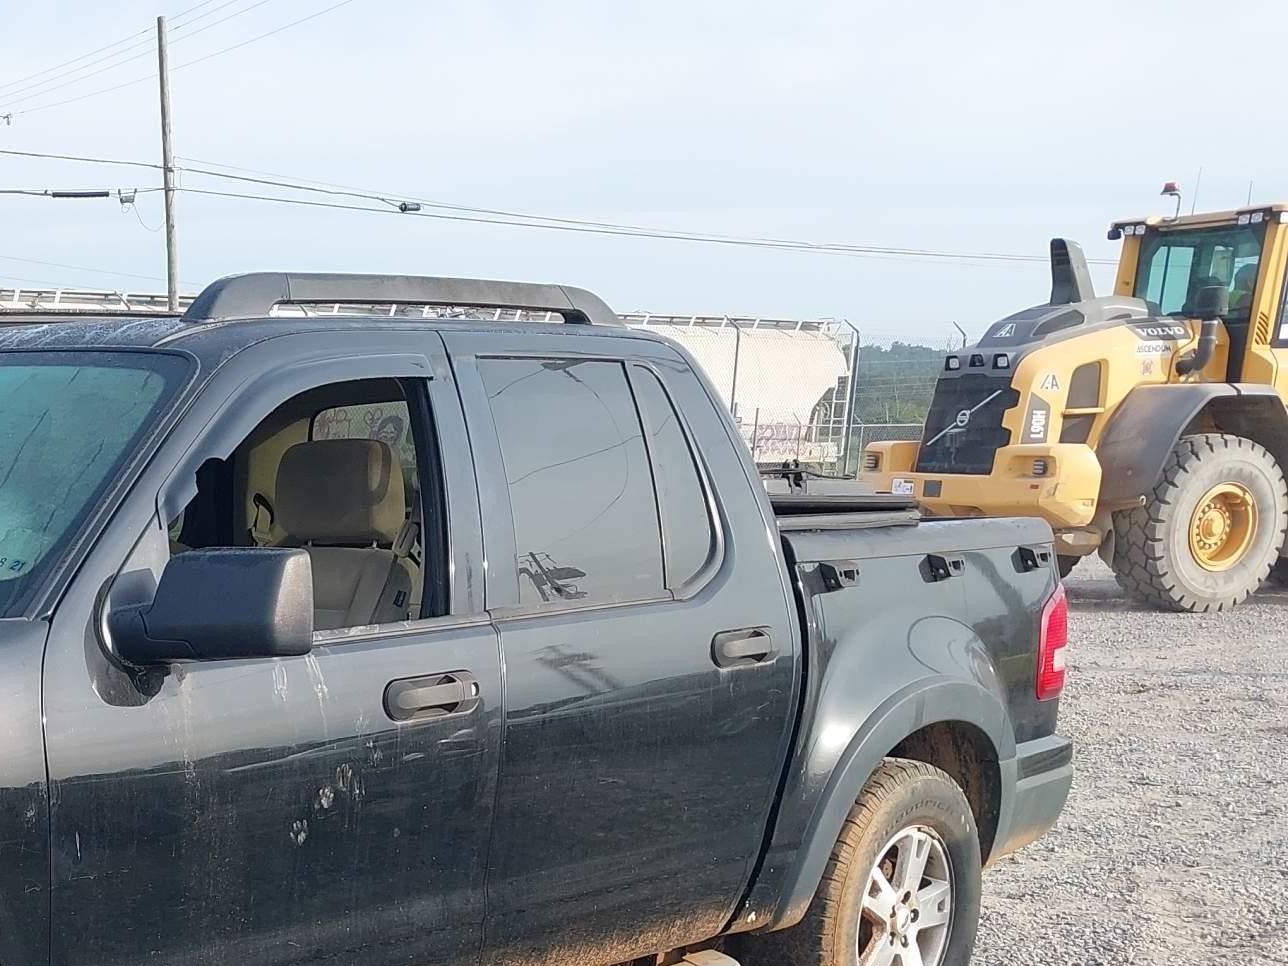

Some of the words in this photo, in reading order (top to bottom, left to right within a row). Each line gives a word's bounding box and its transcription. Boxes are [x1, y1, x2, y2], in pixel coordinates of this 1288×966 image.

[1136, 326, 1184, 336] VOLVO
[1030, 410, 1046, 439] L90H
[9, 560, 25, 571] 21
